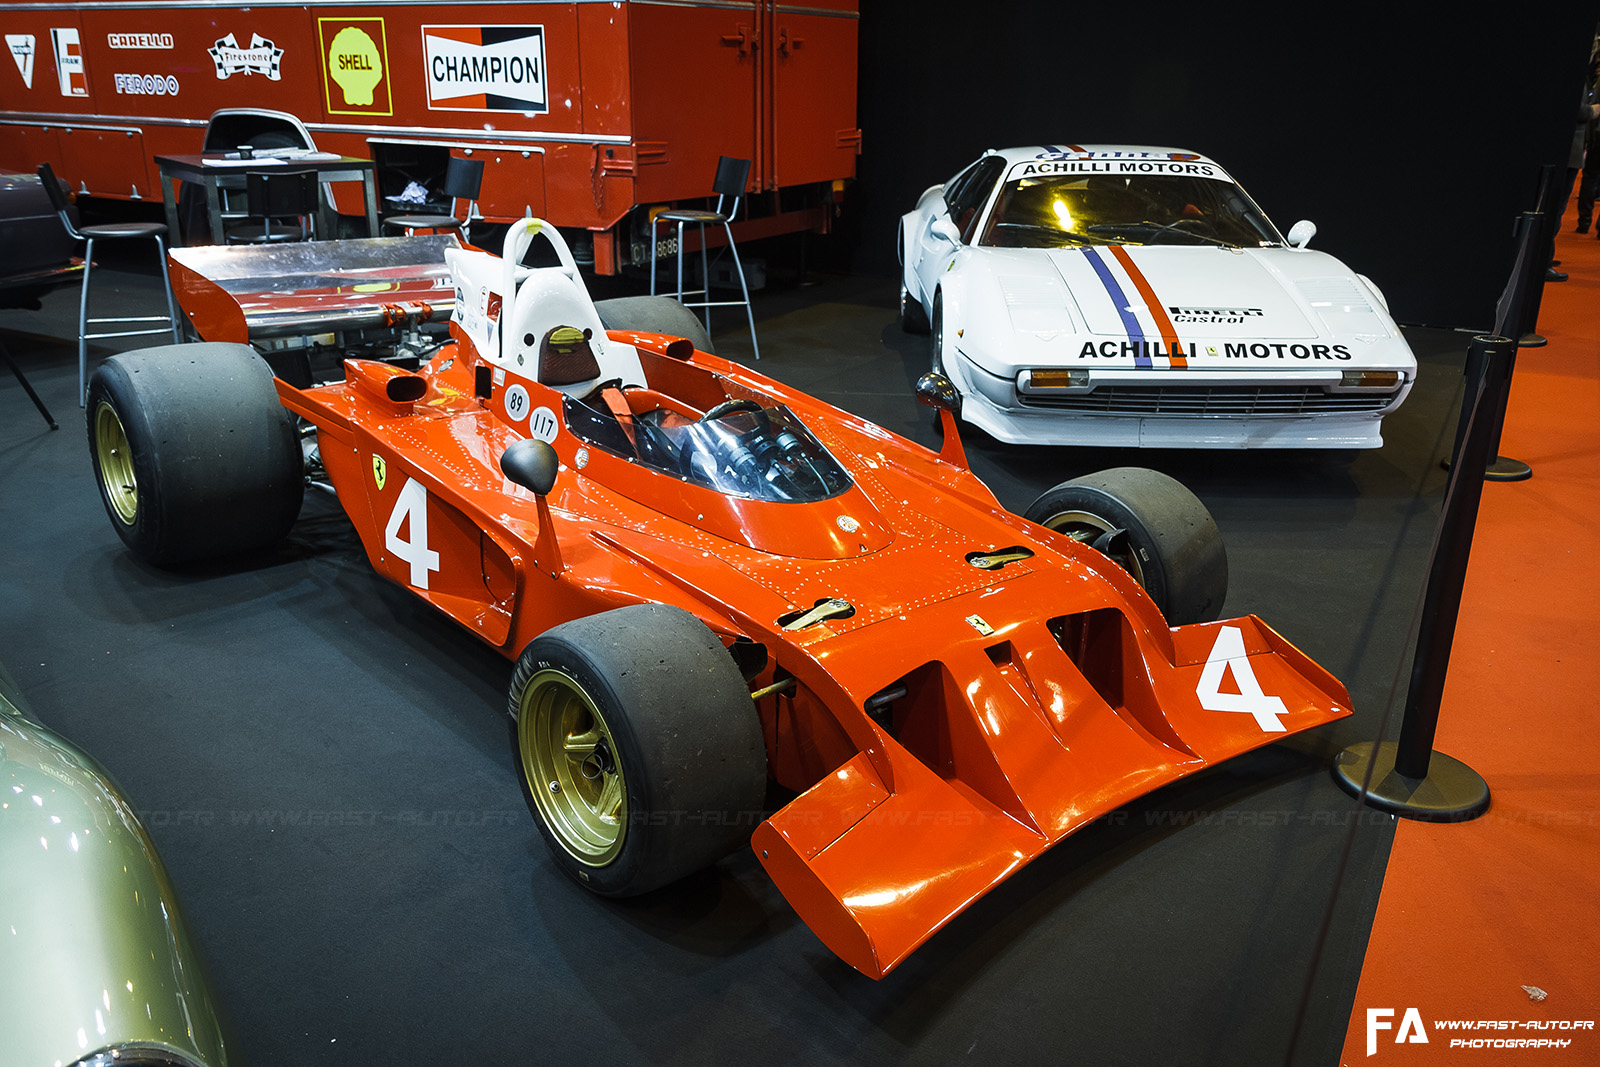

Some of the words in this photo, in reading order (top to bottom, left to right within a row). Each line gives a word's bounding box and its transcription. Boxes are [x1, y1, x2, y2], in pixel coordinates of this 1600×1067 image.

[108, 34, 173, 48] CARELLO
[224, 52, 268, 62] Firestone
[338, 54, 373, 71] SHELL
[432, 55, 539, 84] CHAMPION
[115, 74, 179, 95] FERODO
[1023, 162, 1111, 175] ACHILLI
[1119, 162, 1214, 176] MOTORS
[1168, 306, 1264, 317] PIRELLI
[1174, 315, 1244, 324] Castrol
[1078, 341, 1197, 358] ACHILLI
[1223, 343, 1352, 361] MOTORS
[510, 392, 523, 412] 89
[533, 413, 554, 437] 117
[385, 476, 440, 590] 4
[1195, 625, 1290, 733] 4
